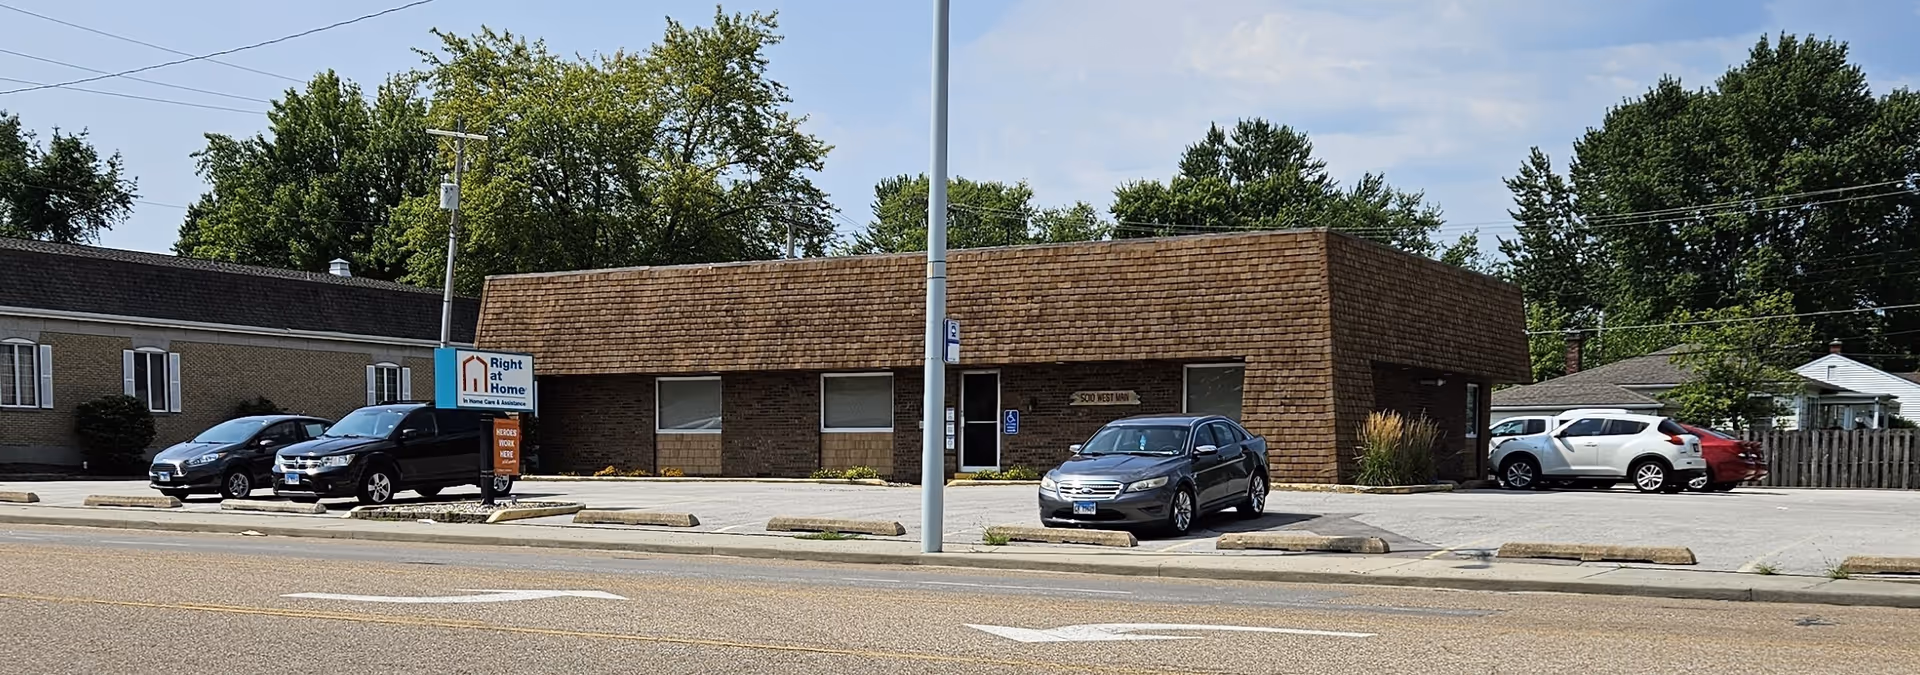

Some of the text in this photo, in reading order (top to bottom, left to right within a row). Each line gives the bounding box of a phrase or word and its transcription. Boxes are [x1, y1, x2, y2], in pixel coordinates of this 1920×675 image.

[490, 357, 523, 371] Right
[490, 371, 503, 381] at
[490, 383, 526, 395] Home
[1096, 393, 1114, 403] WEST
[501, 399, 526, 407] Assistance
[496, 428, 517, 437] HEROES
[498, 439, 515, 447] WORK
[499, 450, 514, 458] HERE
